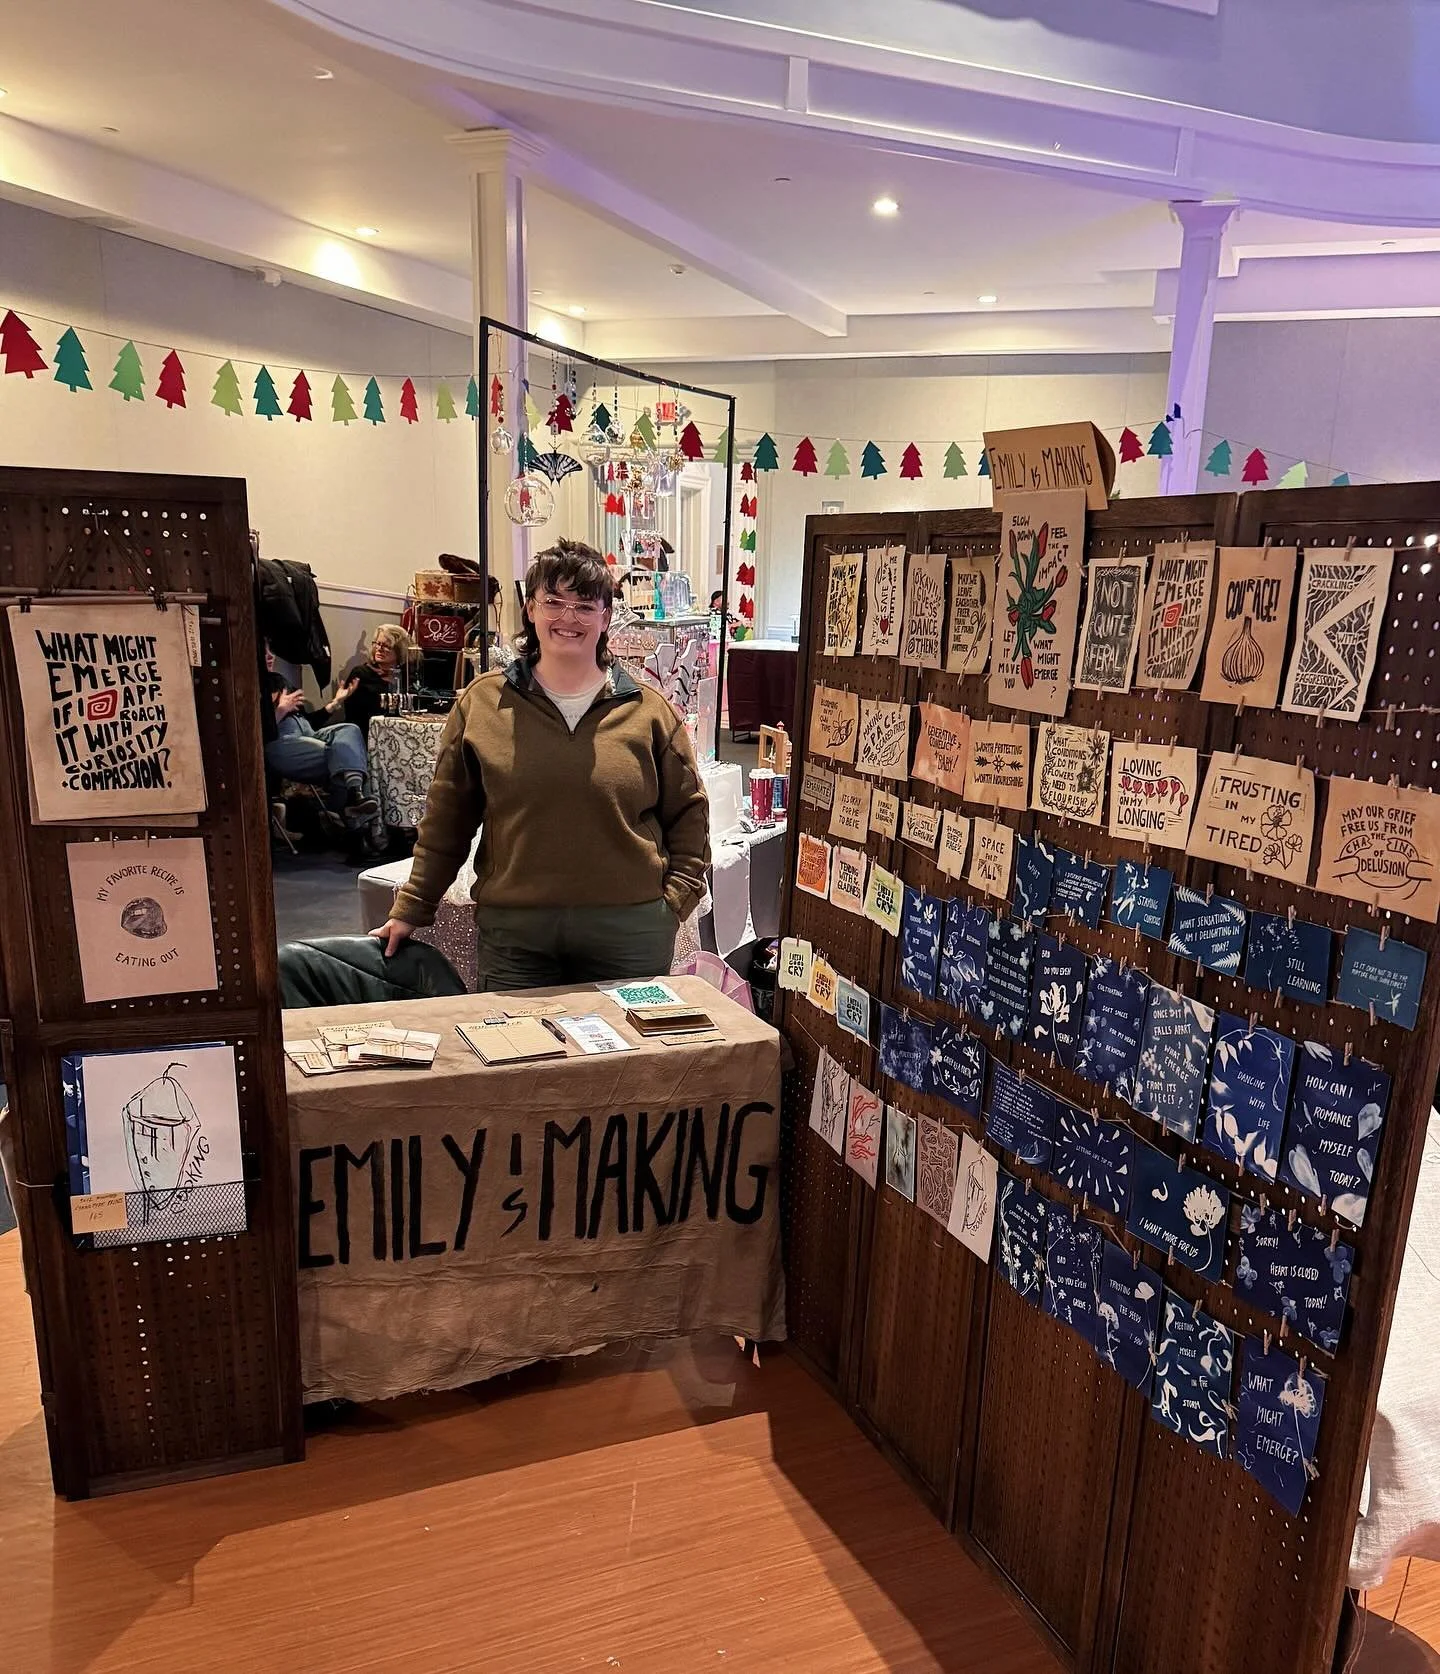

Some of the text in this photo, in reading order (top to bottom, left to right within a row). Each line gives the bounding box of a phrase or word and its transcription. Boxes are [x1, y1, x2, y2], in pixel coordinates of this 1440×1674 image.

[989, 445, 1092, 490] EMILY IS MAKING
[1012, 516, 1030, 527] SLOW
[1017, 530, 1035, 541] DOWN
[1051, 527, 1068, 539] FEEL
[848, 562, 858, 574] MY
[1039, 545, 1069, 582] IMPACT
[1158, 559, 1208, 583] WHAT MIGHT
[1312, 579, 1353, 590] CRACKLING
[880, 586, 889, 612] SAFE
[1101, 579, 1133, 608] NOT
[1153, 580, 1204, 611] EMERGE
[910, 619, 939, 638] DANCE,
[1094, 612, 1132, 638] QUITE
[1150, 612, 1160, 632] IF
[1004, 630, 1015, 643] LET
[1034, 639, 1054, 651] WHAT
[1147, 626, 1183, 658] IT WITH
[1336, 632, 1358, 644] WITH
[35, 629, 98, 664] WHAT
[102, 634, 157, 666] MIGHT
[1004, 648, 1010, 658] IT
[1147, 628, 1199, 665] CURIOSITY
[1037, 653, 1061, 666] MIGHT
[1090, 644, 1122, 672] FERAL
[998, 663, 1020, 675] MOVE
[1034, 668, 1059, 681] EMERGE
[46, 661, 162, 701] EMERGE
[1004, 677, 1015, 689] YOU
[1299, 674, 1338, 687] AGGRESSION
[53, 698, 85, 729] IF I
[120, 705, 166, 722] ROACH
[864, 710, 882, 740] MAKING
[55, 720, 133, 765] IT WITH
[928, 725, 957, 745] GENERATIVE
[1053, 738, 1068, 748] WHAT
[65, 722, 169, 775] CURIOSITY
[976, 742, 1023, 755] WORTH PROTECTING
[1052, 747, 1087, 760] CONDITIONS
[1058, 760, 1078, 770] DO MY
[1122, 758, 1162, 777] LOVING
[974, 772, 1024, 787] WORTH NOURISHING
[1048, 769, 1075, 781] FLOWERS
[1052, 780, 1077, 793] NEED TO
[1220, 776, 1302, 809] TRUSTING
[1048, 790, 1088, 807] FLOURISH?
[1120, 796, 1143, 807] ON MY
[1225, 800, 1239, 810] IN
[1118, 806, 1166, 830] LONGING
[1240, 814, 1256, 825] MY
[1342, 806, 1417, 826] MAY OUR GRIEF
[920, 820, 933, 833] STILL
[1340, 820, 1413, 839] FREE US FROM
[913, 828, 935, 844] GROWING
[1206, 825, 1263, 853] TIRED
[1370, 832, 1386, 841] THE
[981, 836, 1005, 855] SPACE
[1374, 850, 1385, 858] OF
[981, 864, 997, 881] ALL
[1360, 858, 1406, 877] DELUSION
[96, 864, 185, 902] MY FAVORITE RECIPE IS
[876, 898, 894, 916] CRY
[1137, 896, 1159, 910] STAYING
[1144, 914, 1162, 926] CURIOUS
[1180, 913, 1232, 930] WHAT SENSATIONS
[1184, 926, 1240, 943] AM I DELIGHTING IN
[1211, 941, 1230, 955] TODAY?
[115, 948, 180, 967] EATING OUT
[1286, 957, 1306, 973] STILL
[788, 966, 804, 978] CRY
[1044, 966, 1072, 976] DO YOU EVEN
[815, 984, 831, 1001] CRY
[1097, 984, 1124, 998] CULTIVATING
[1287, 975, 1322, 995] LEARNING
[846, 1009, 862, 1026] CRY
[1153, 1009, 1168, 1020] ONCE
[1110, 1027, 1118, 1037] FOR
[1124, 1036, 1137, 1047] HEART
[1154, 1024, 1192, 1037] FALLS APART
[1164, 1045, 1201, 1077] WHAT MIGHT
[1164, 1057, 1190, 1084] EMERGE
[1146, 1080, 1177, 1092] FROM ITS
[1237, 1070, 1266, 1090] DANCING
[1305, 1075, 1353, 1098] HOW CAN I
[1150, 1093, 1176, 1106] PIECES
[1249, 1096, 1265, 1111] WITH
[1257, 1117, 1271, 1130] LIFE
[1314, 1106, 1353, 1128] ROMANCE
[1319, 1139, 1354, 1158] MYSELF
[298, 1102, 775, 1270] EMILY IS MAKING
[1330, 1170, 1361, 1189] TODAY?
[1139, 1216, 1199, 1258] I WANT MORE FOR US
[1256, 1235, 1279, 1249] SORRY!
[1270, 1262, 1320, 1281] HEART IS CLOSED
[1057, 1276, 1087, 1289] DO YOU EVEN
[1110, 1279, 1131, 1296] TRUSTING
[1304, 1294, 1328, 1310] TODAY!
[1120, 1304, 1142, 1324] THE SEEDS
[1174, 1321, 1195, 1332] MEETING
[1134, 1335, 1144, 1346] SOW
[1180, 1347, 1197, 1358] MYSELF
[1191, 1379, 1198, 1388] IN
[1248, 1372, 1274, 1393] WHAT
[1182, 1400, 1201, 1410] STORM
[1256, 1406, 1284, 1427] MIGHT
[1256, 1434, 1300, 1466] EMERGE?
